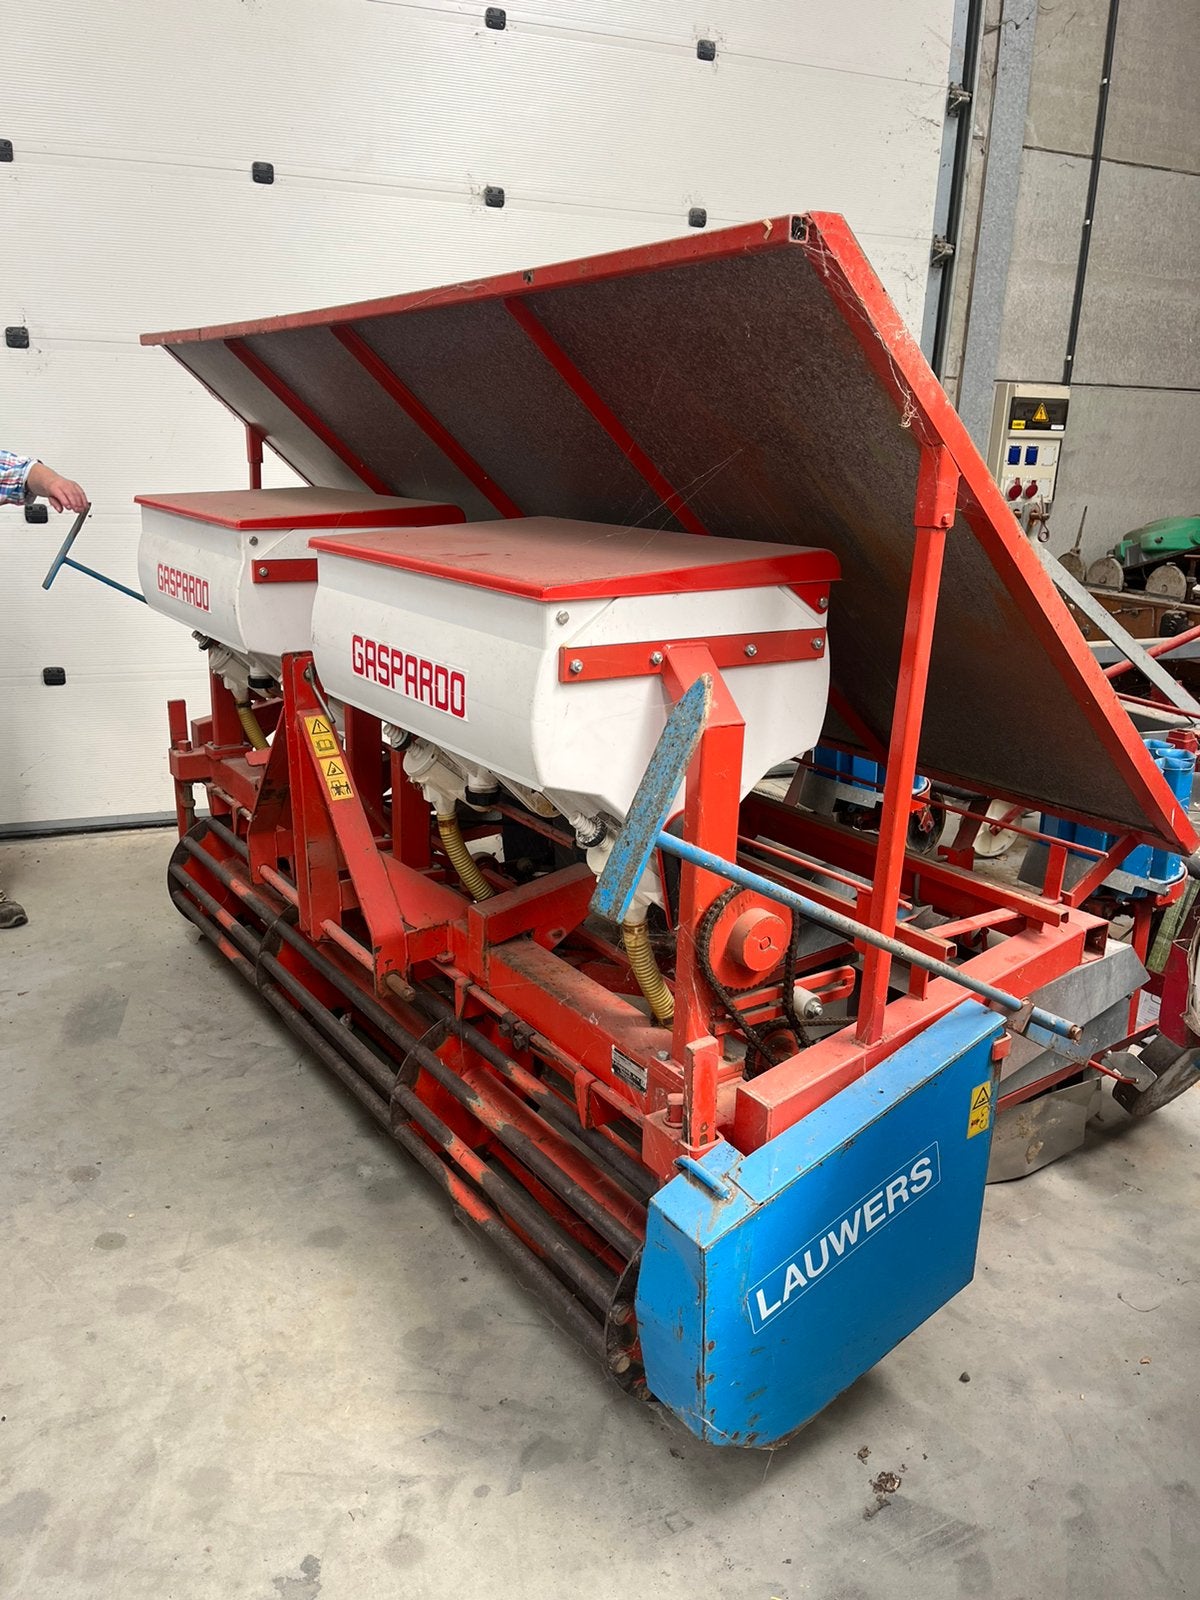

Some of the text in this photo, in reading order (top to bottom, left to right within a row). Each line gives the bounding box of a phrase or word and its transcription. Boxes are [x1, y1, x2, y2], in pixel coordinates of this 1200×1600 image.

[157, 563, 209, 611] GASPARDO
[352, 634, 465, 718] GASPARDO
[756, 1157, 932, 1320] LAUWERS
